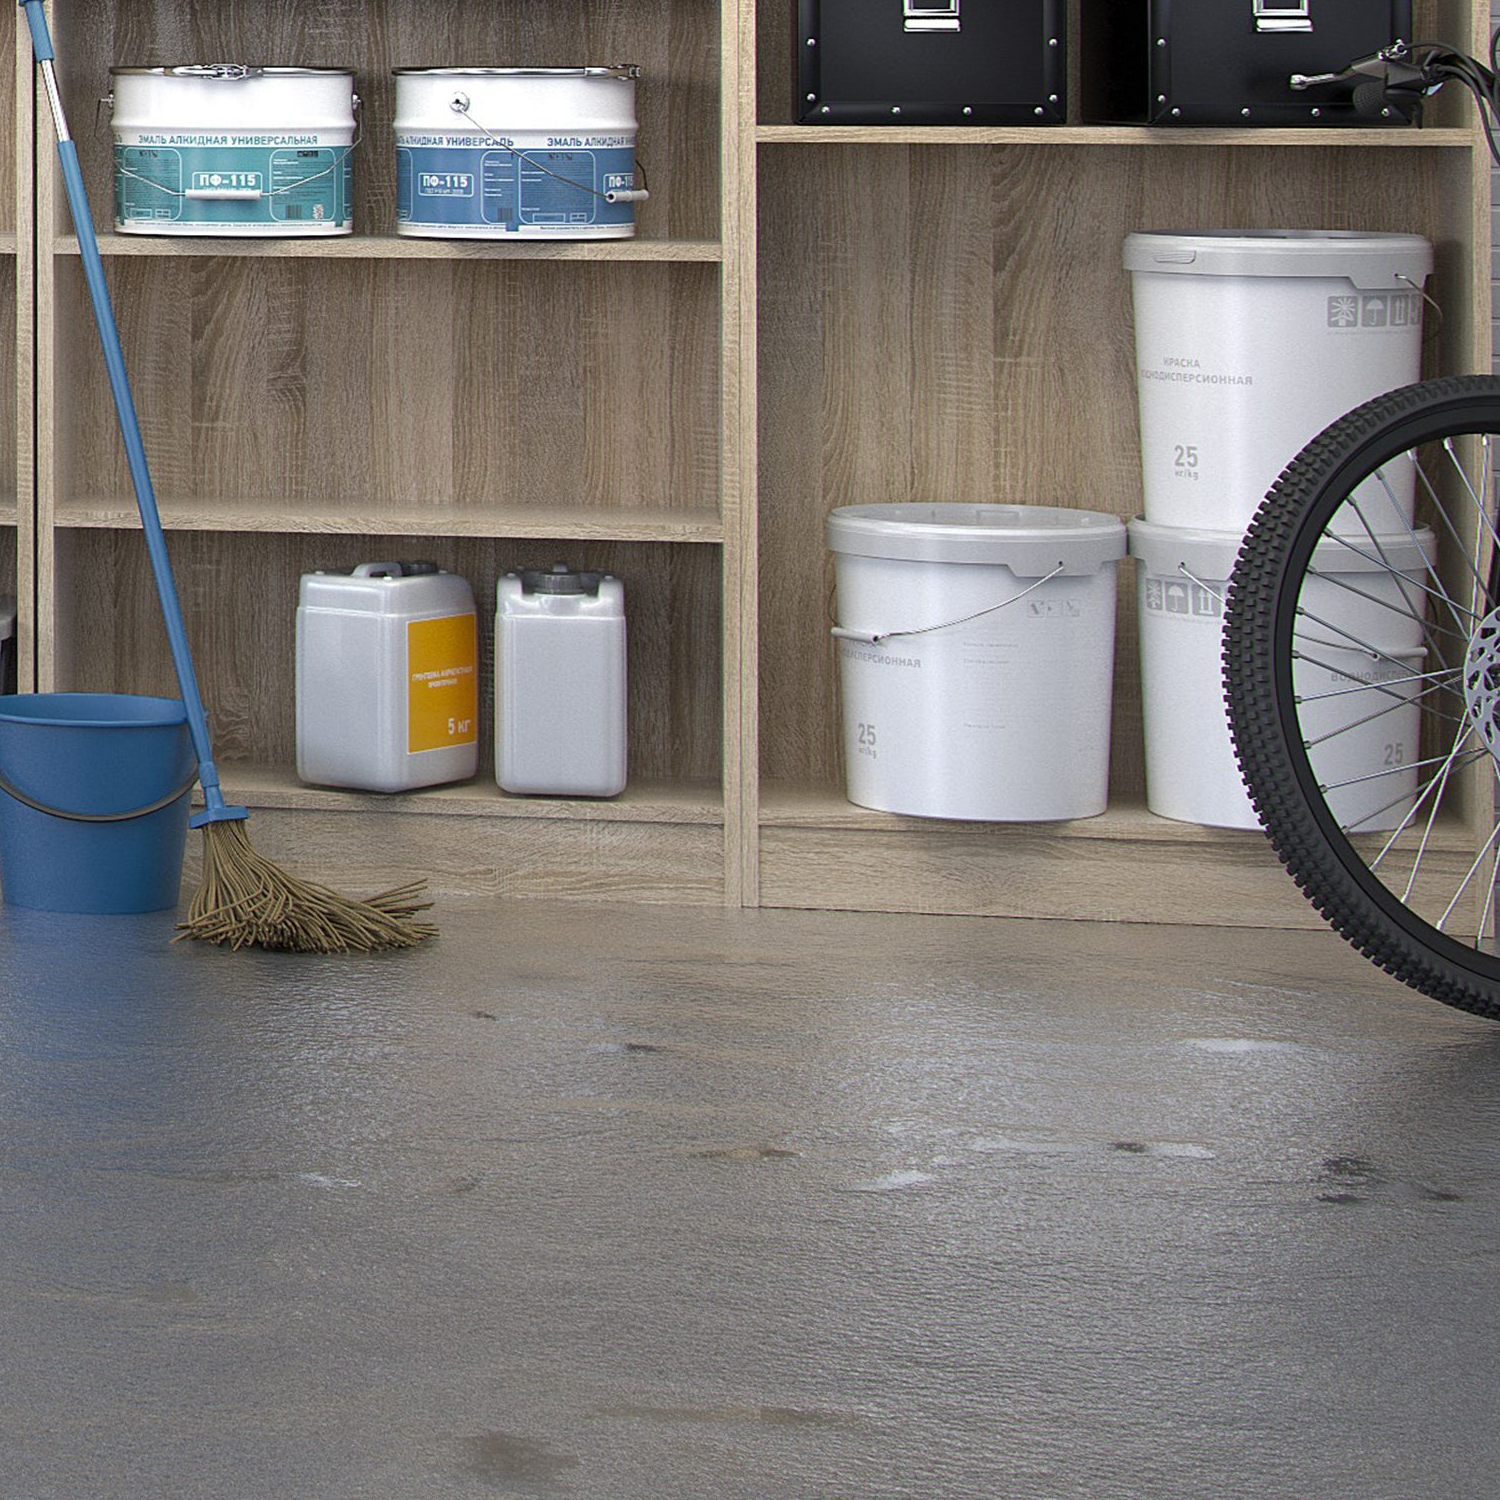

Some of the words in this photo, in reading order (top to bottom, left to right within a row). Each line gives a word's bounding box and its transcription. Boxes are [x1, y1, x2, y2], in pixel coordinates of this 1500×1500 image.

[138, 135, 167, 145] ЭМАЛЬ
[169, 135, 228, 146] АЛКИДНАЯ
[231, 135, 318, 146] УНИВЕРСАЛЬНАЯ
[547, 137, 582, 147] ЭМАЛЬ
[200, 174, 256, 186] ПФ-115
[423, 175, 468, 188] ПФ-115
[1163, 357, 1200, 368] КРАСКА
[1174, 444, 1198, 468] 25
[447, 717, 455, 736] 5
[858, 723, 876, 746] 25
[1384, 742, 1404, 765] 25
